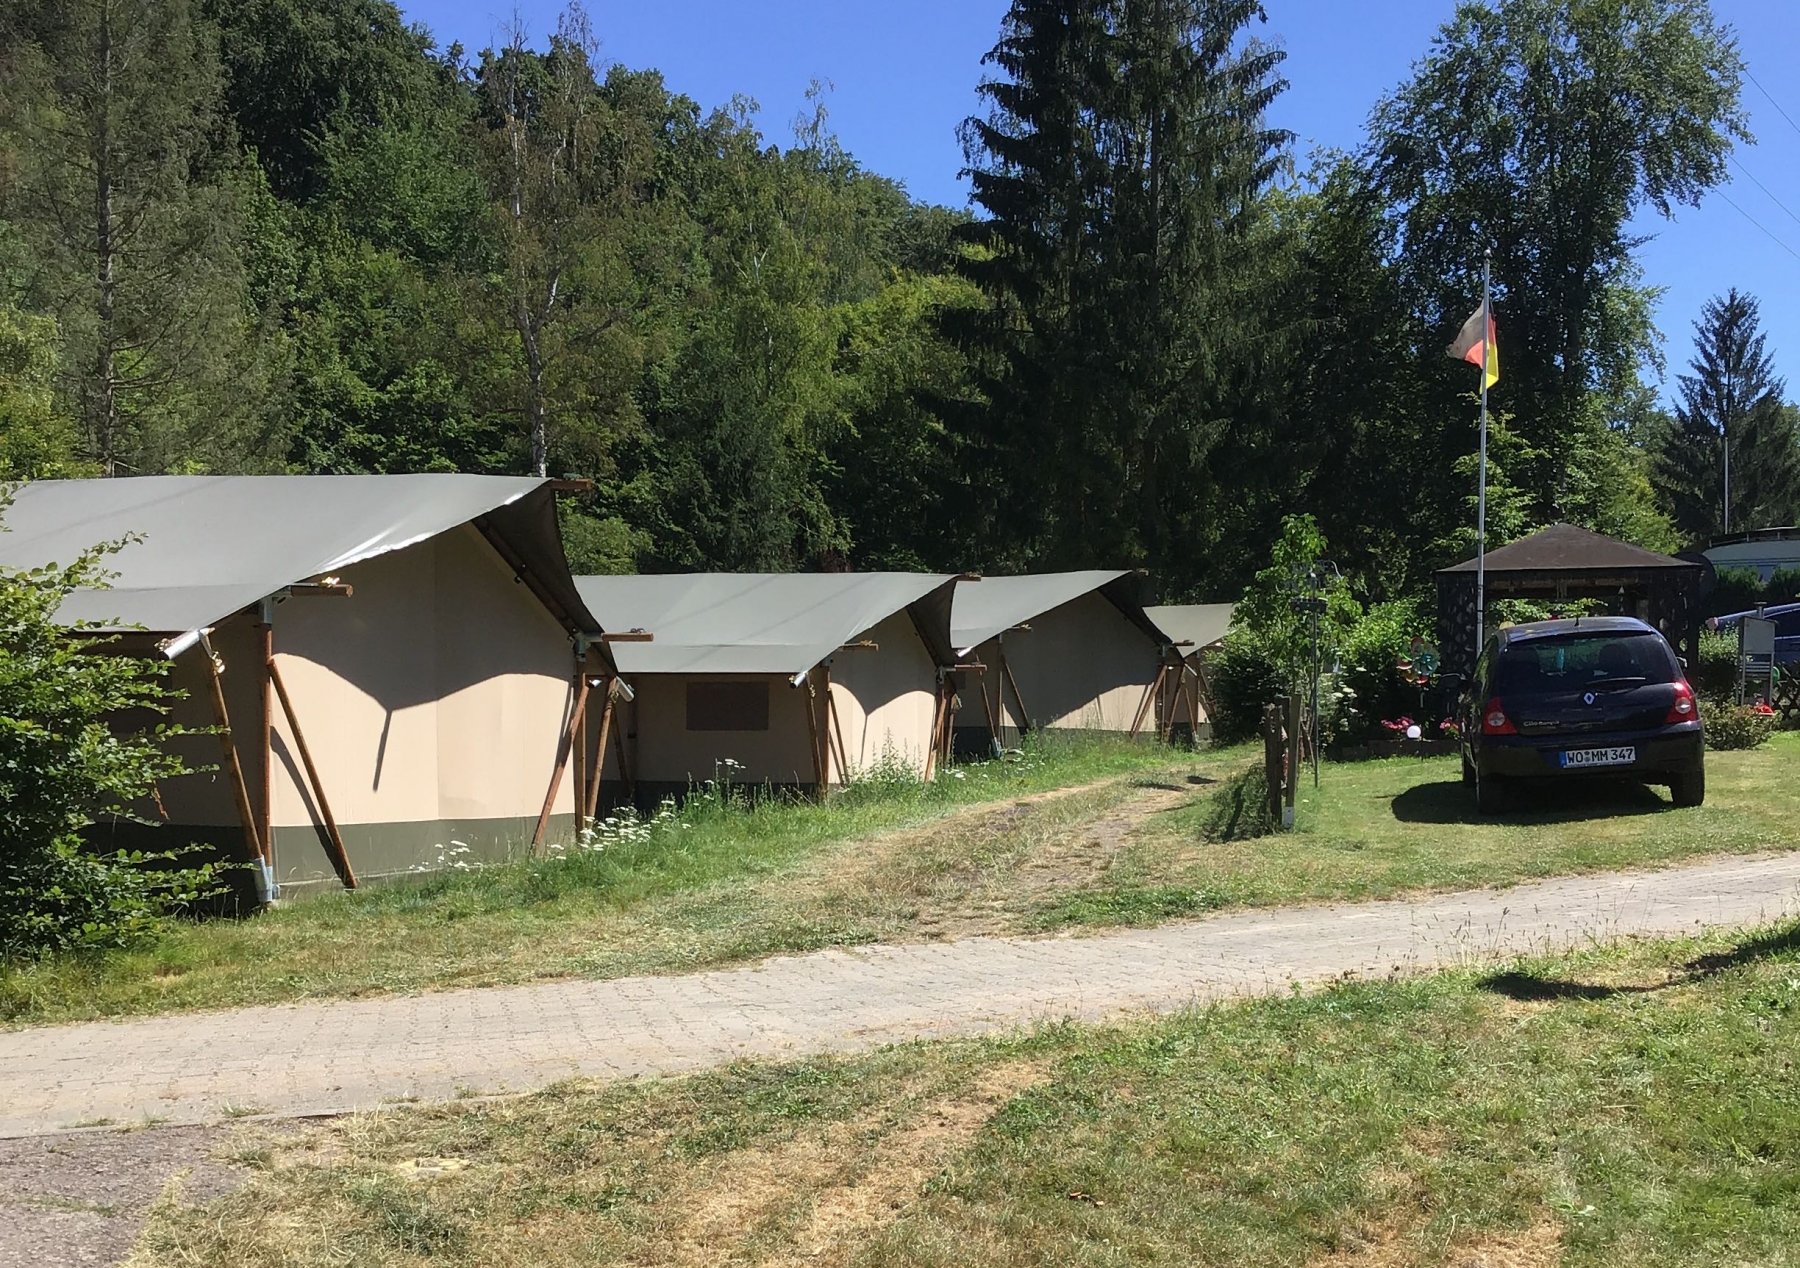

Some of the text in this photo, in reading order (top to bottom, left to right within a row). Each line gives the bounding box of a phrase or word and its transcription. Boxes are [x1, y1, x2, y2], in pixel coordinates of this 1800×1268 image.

[1567, 748, 1634, 764] WO MM 347
